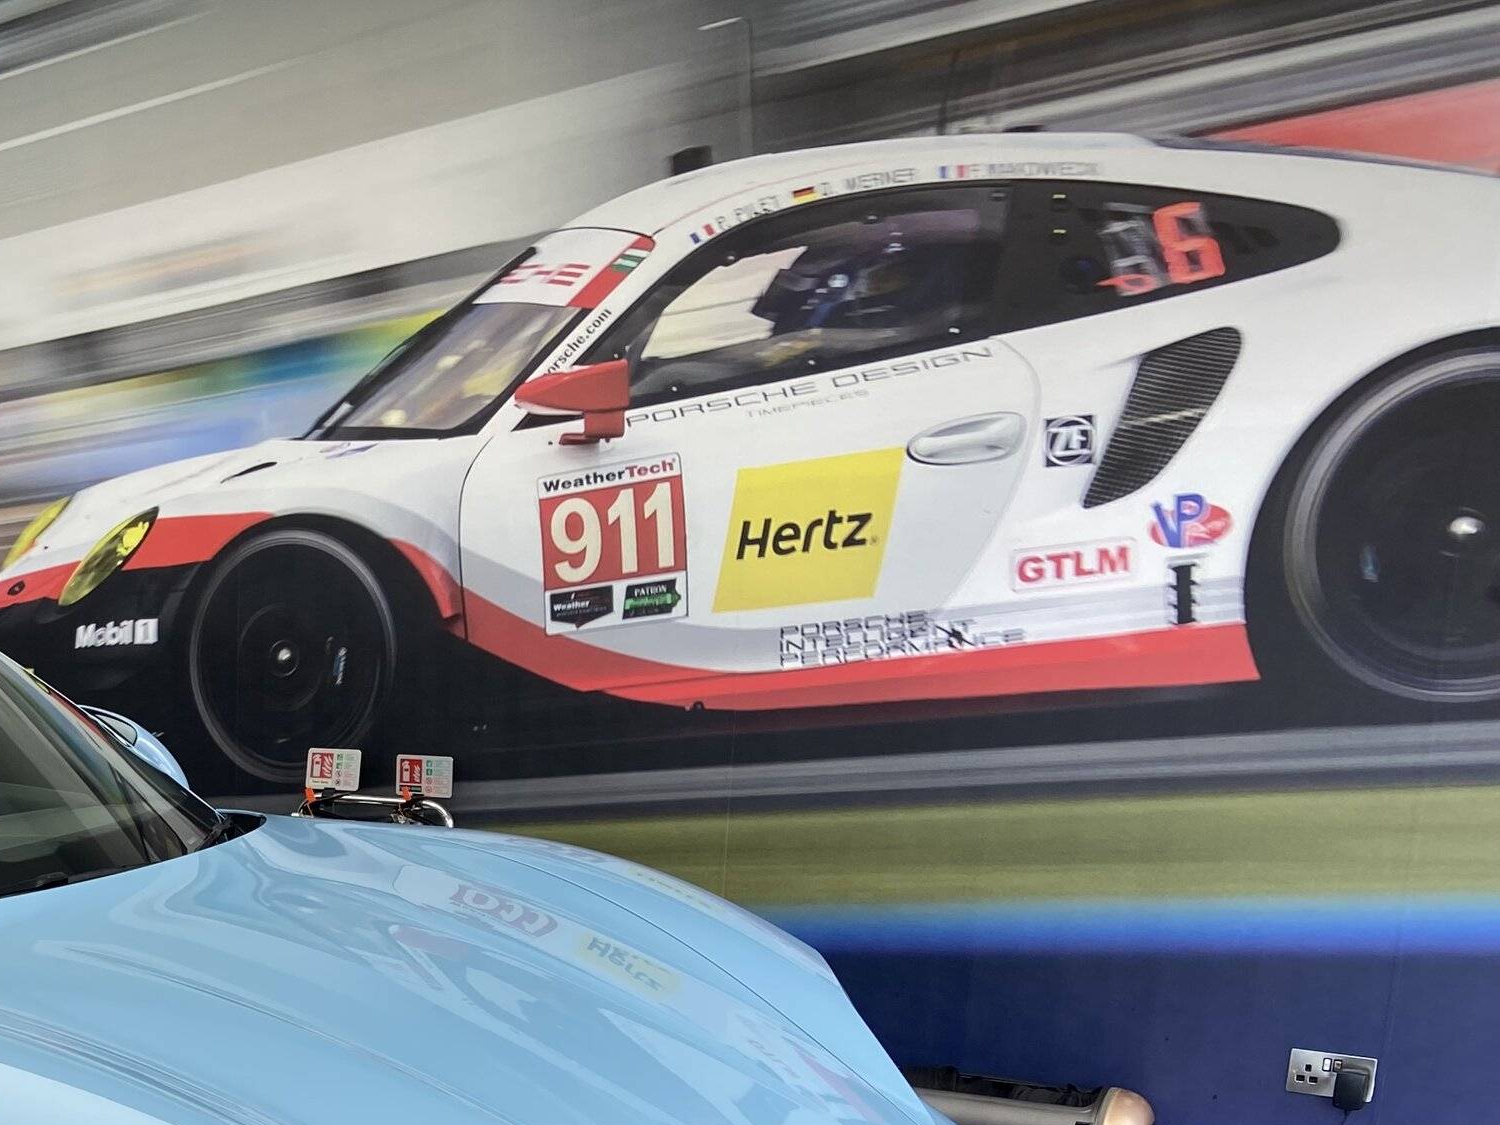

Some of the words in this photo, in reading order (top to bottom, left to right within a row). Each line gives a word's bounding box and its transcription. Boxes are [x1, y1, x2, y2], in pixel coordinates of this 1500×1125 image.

[625, 381, 818, 428] PORSCHE
[832, 347, 994, 388] DESIGN
[1048, 425, 1092, 456] ZF
[543, 459, 675, 493] WeatherTech
[550, 481, 675, 584] 911
[736, 509, 873, 561] Hertz
[1152, 493, 1206, 549] VP
[1017, 545, 1131, 584] GTLM
[74, 619, 134, 650] Mobil
